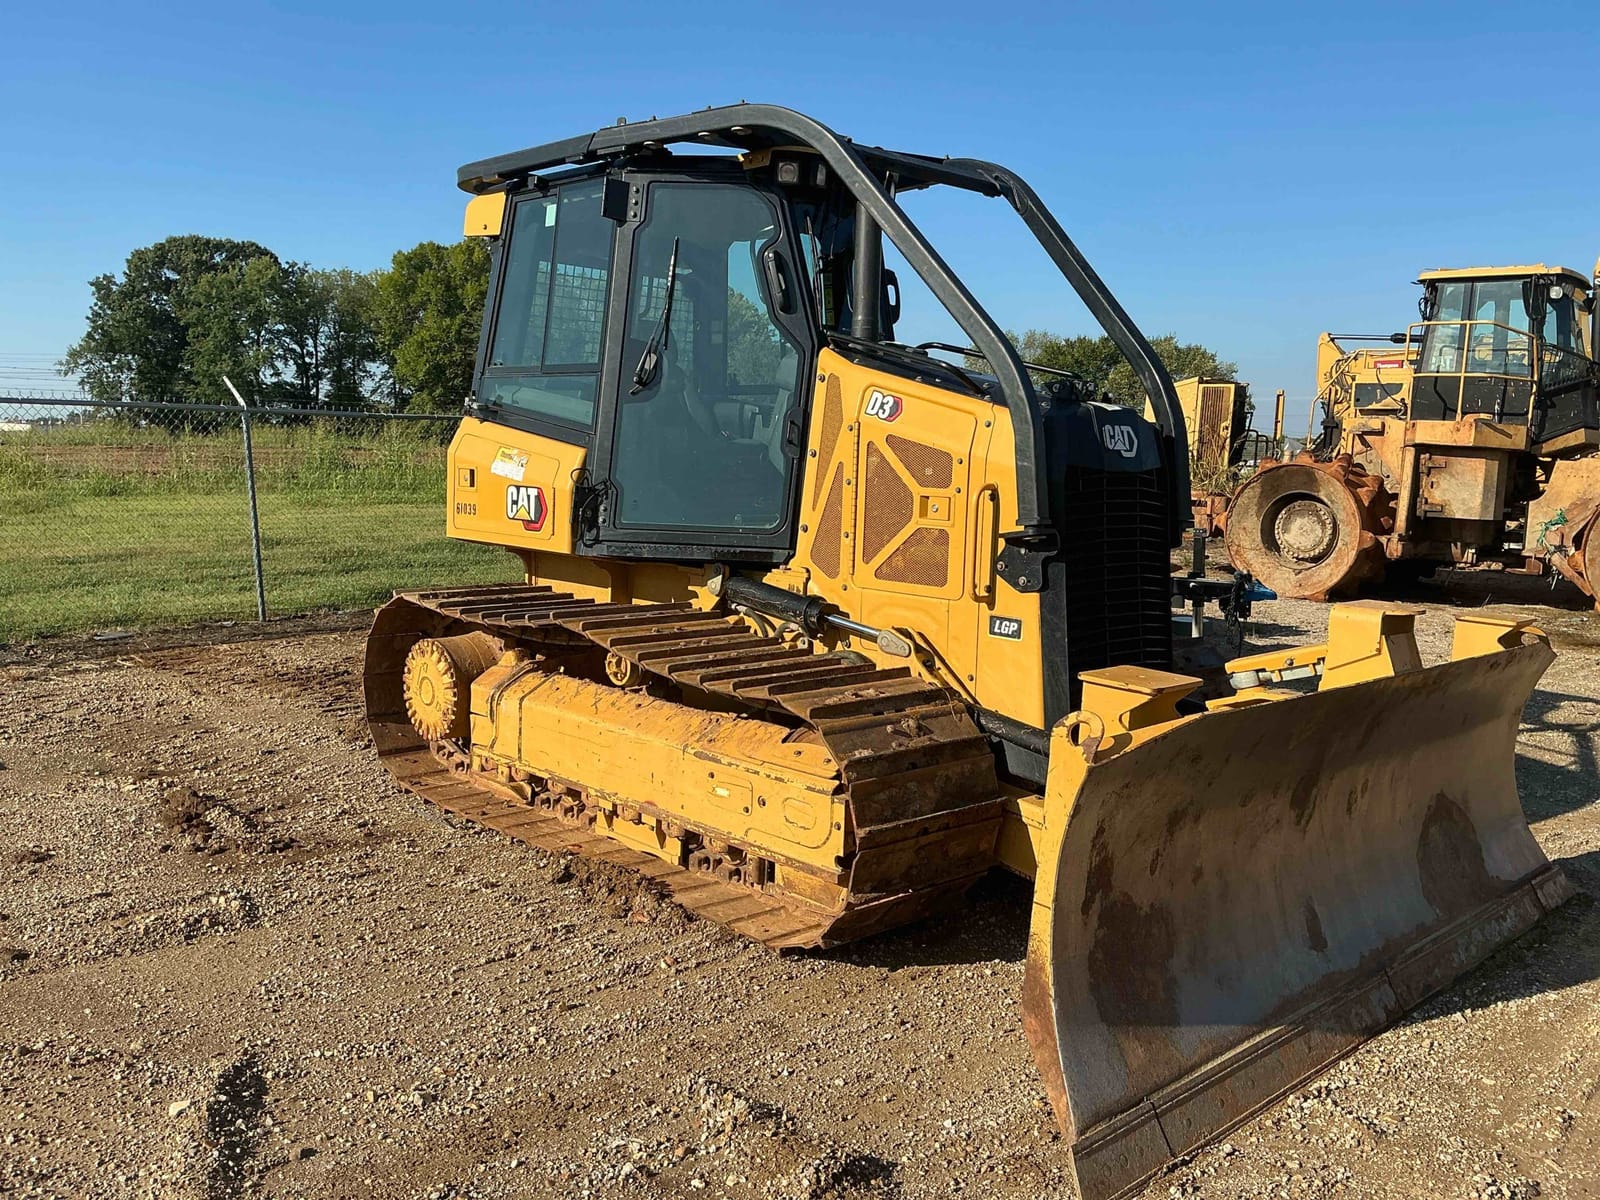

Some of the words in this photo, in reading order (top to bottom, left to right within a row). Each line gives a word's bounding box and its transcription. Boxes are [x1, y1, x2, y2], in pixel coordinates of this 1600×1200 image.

[865, 390, 894, 419] D3
[1103, 424, 1133, 450] CAT
[456, 502, 477, 516] 61039
[506, 485, 539, 521] CAT
[994, 619, 1018, 635] LGP
